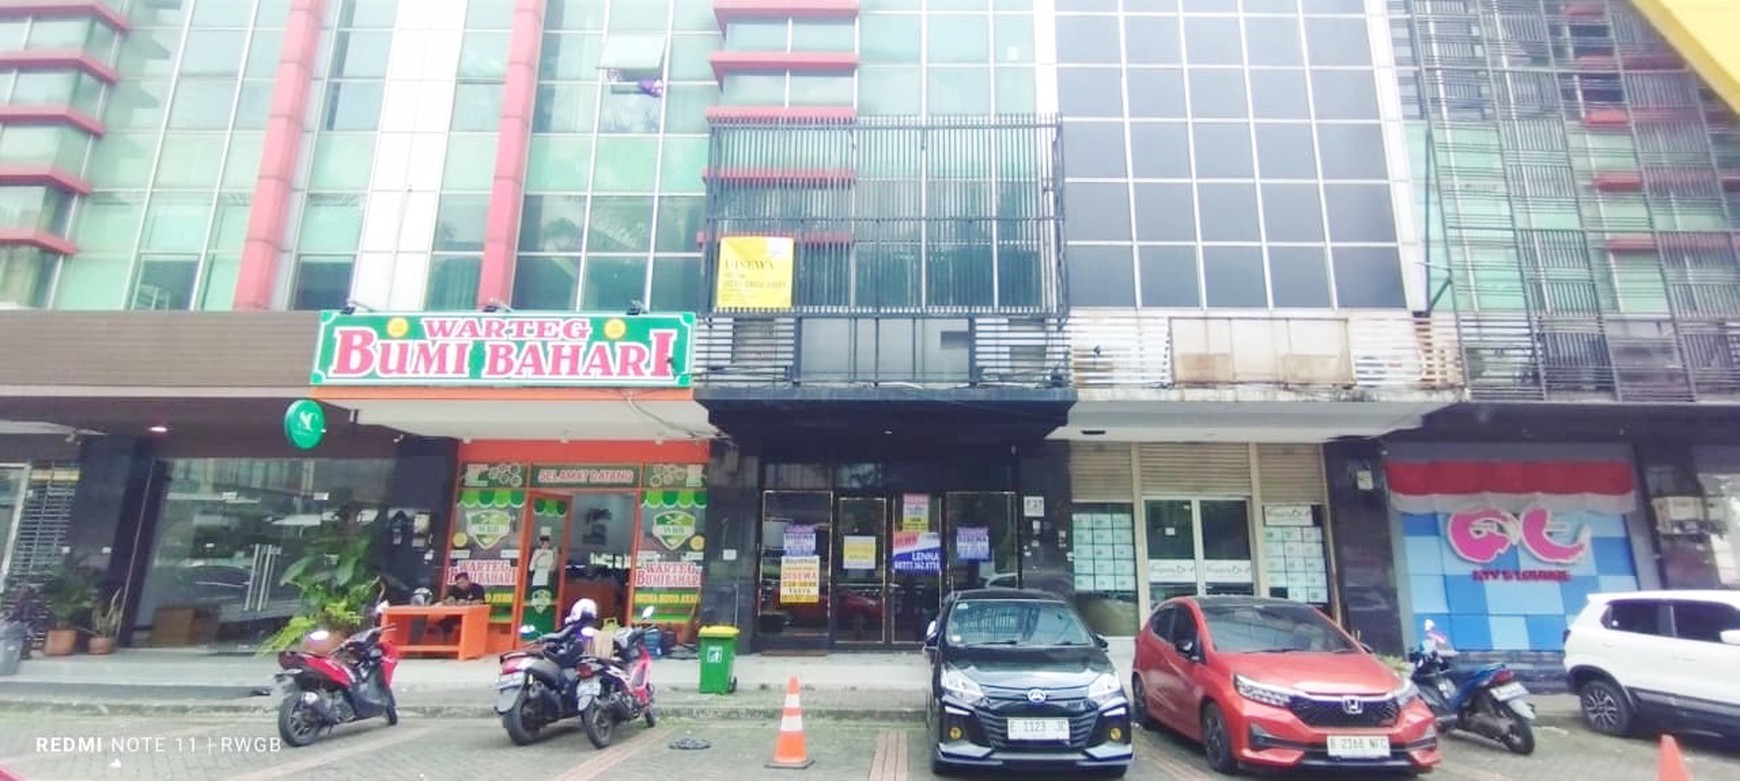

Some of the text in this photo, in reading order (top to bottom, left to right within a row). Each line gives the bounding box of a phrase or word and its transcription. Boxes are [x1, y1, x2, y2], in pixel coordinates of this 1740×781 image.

[424, 318, 591, 340] WARTEG
[332, 329, 675, 378] BUMI BAHARI
[540, 470, 633, 482] SELAMAT DATANG
[1023, 720, 1047, 732] 1123
